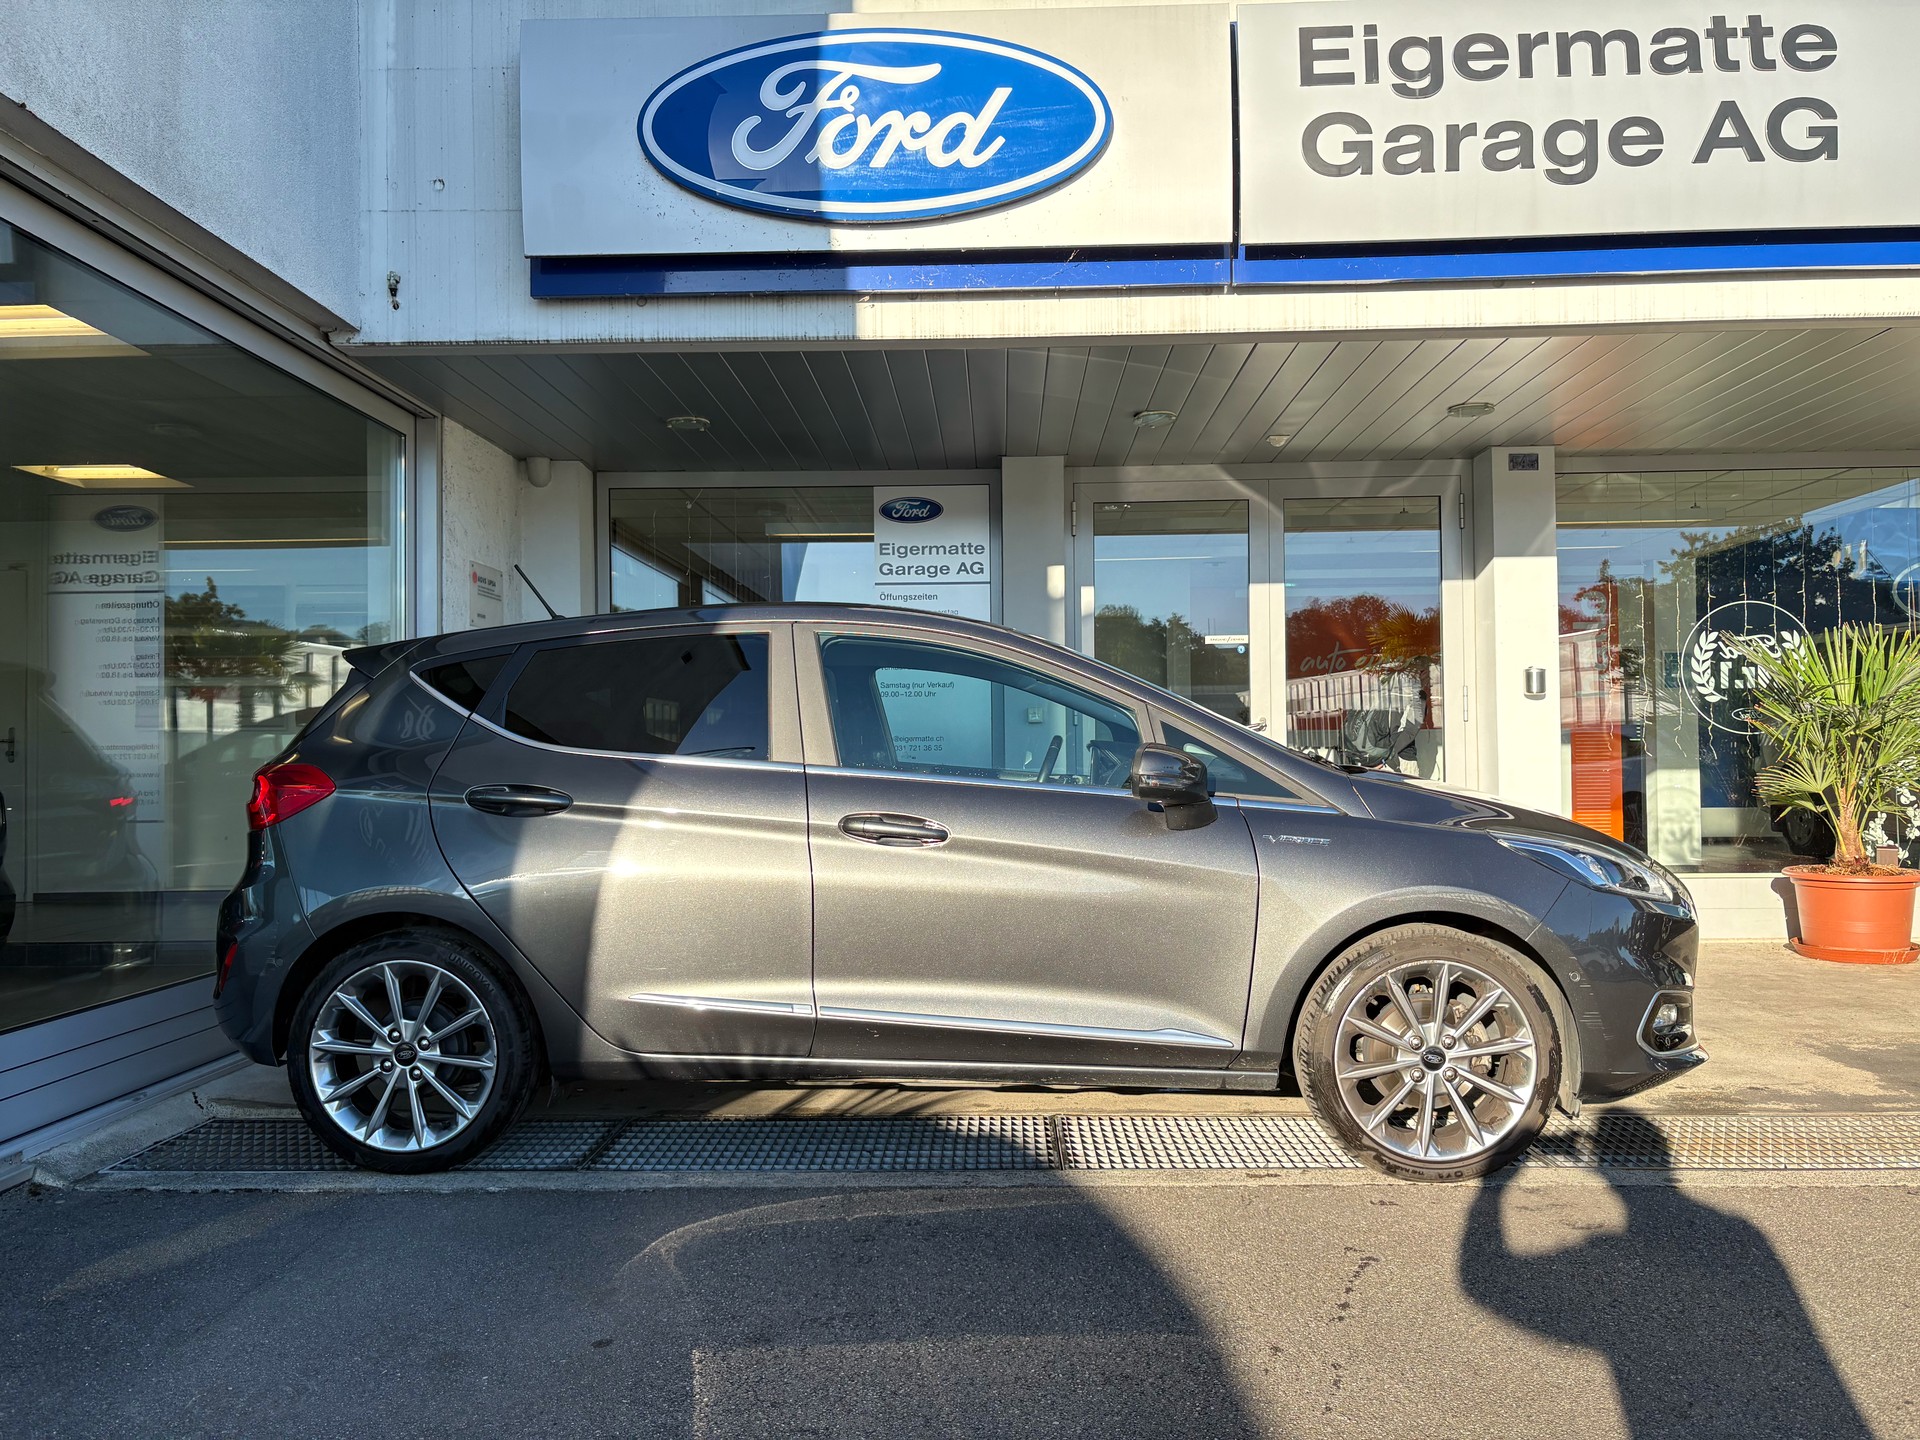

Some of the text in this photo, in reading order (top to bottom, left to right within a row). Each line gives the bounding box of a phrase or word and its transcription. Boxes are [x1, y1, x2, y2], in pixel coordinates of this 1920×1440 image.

[1298, 14, 1839, 99] Eigermatte
[731, 59, 1013, 171] Ford
[1301, 96, 1839, 186] Garage AG
[892, 501, 930, 518] Ford
[879, 542, 986, 559] Eigermatte
[879, 561, 985, 578] Garage AG
[880, 681, 955, 690] Samstag (nur Verkauf)
